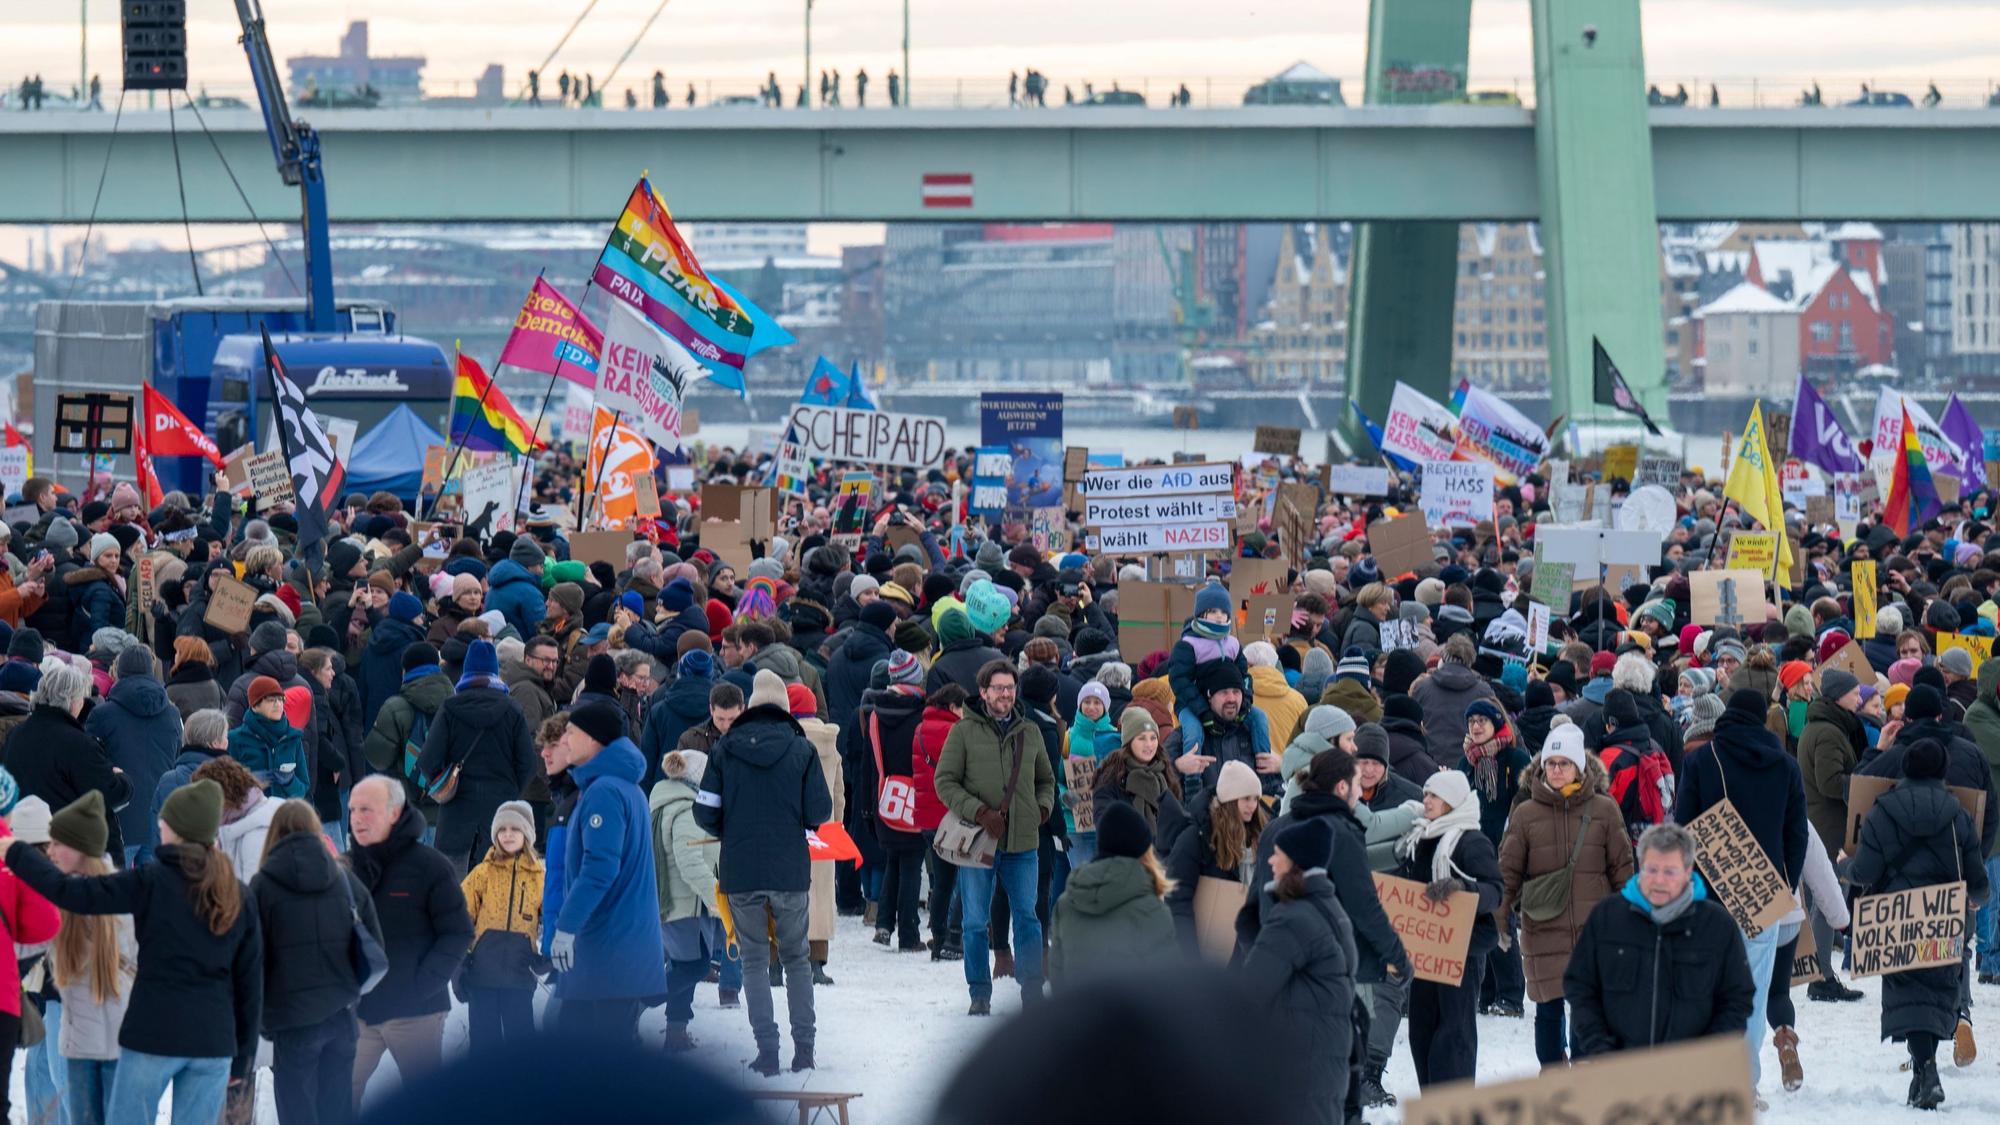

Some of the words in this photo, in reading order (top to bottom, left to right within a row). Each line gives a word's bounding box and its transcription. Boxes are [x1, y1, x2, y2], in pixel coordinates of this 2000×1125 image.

[610, 273, 645, 307] PAIX
[559, 343, 593, 366] FDP
[607, 341, 652, 379] KEIN
[1391, 410, 1418, 433] KEIN
[1459, 415, 1490, 441] KEIN
[889, 418, 945, 466] AfD
[1455, 430, 1536, 478] RASSISMUS
[1087, 473, 1121, 491] Wer
[1128, 473, 1153, 490] die
[1161, 471, 1193, 488] AfD
[1427, 463, 1479, 476] RECHTER
[1445, 477, 1484, 493] HASS
[973, 485, 1008, 508] RAUS
[1088, 504, 1151, 520] Protest
[1156, 500, 1204, 518] wählt
[1102, 530, 1149, 548] wählt
[1164, 526, 1226, 545] NAZIS!
[1704, 812, 1754, 873] ANTWORT
[1745, 873, 1775, 907] SEIN
[1718, 803, 1750, 843] WENN
[1762, 870, 1784, 896] DIE
[1691, 818, 1715, 850] SOLL
[1713, 846, 1736, 875] WIE
[1727, 872, 1764, 918] DUMM
[1715, 880, 1733, 901] DIE
[1858, 891, 1916, 927] EGAL
[1922, 886, 1962, 918] WIE
[1391, 914, 1455, 945] GEGEN
[1855, 924, 1897, 950] VOLK
[1900, 922, 1925, 943] IHR
[1925, 917, 1964, 940] SEID
[1853, 947, 1881, 975] WIR
[1882, 941, 1917, 968] SIND
